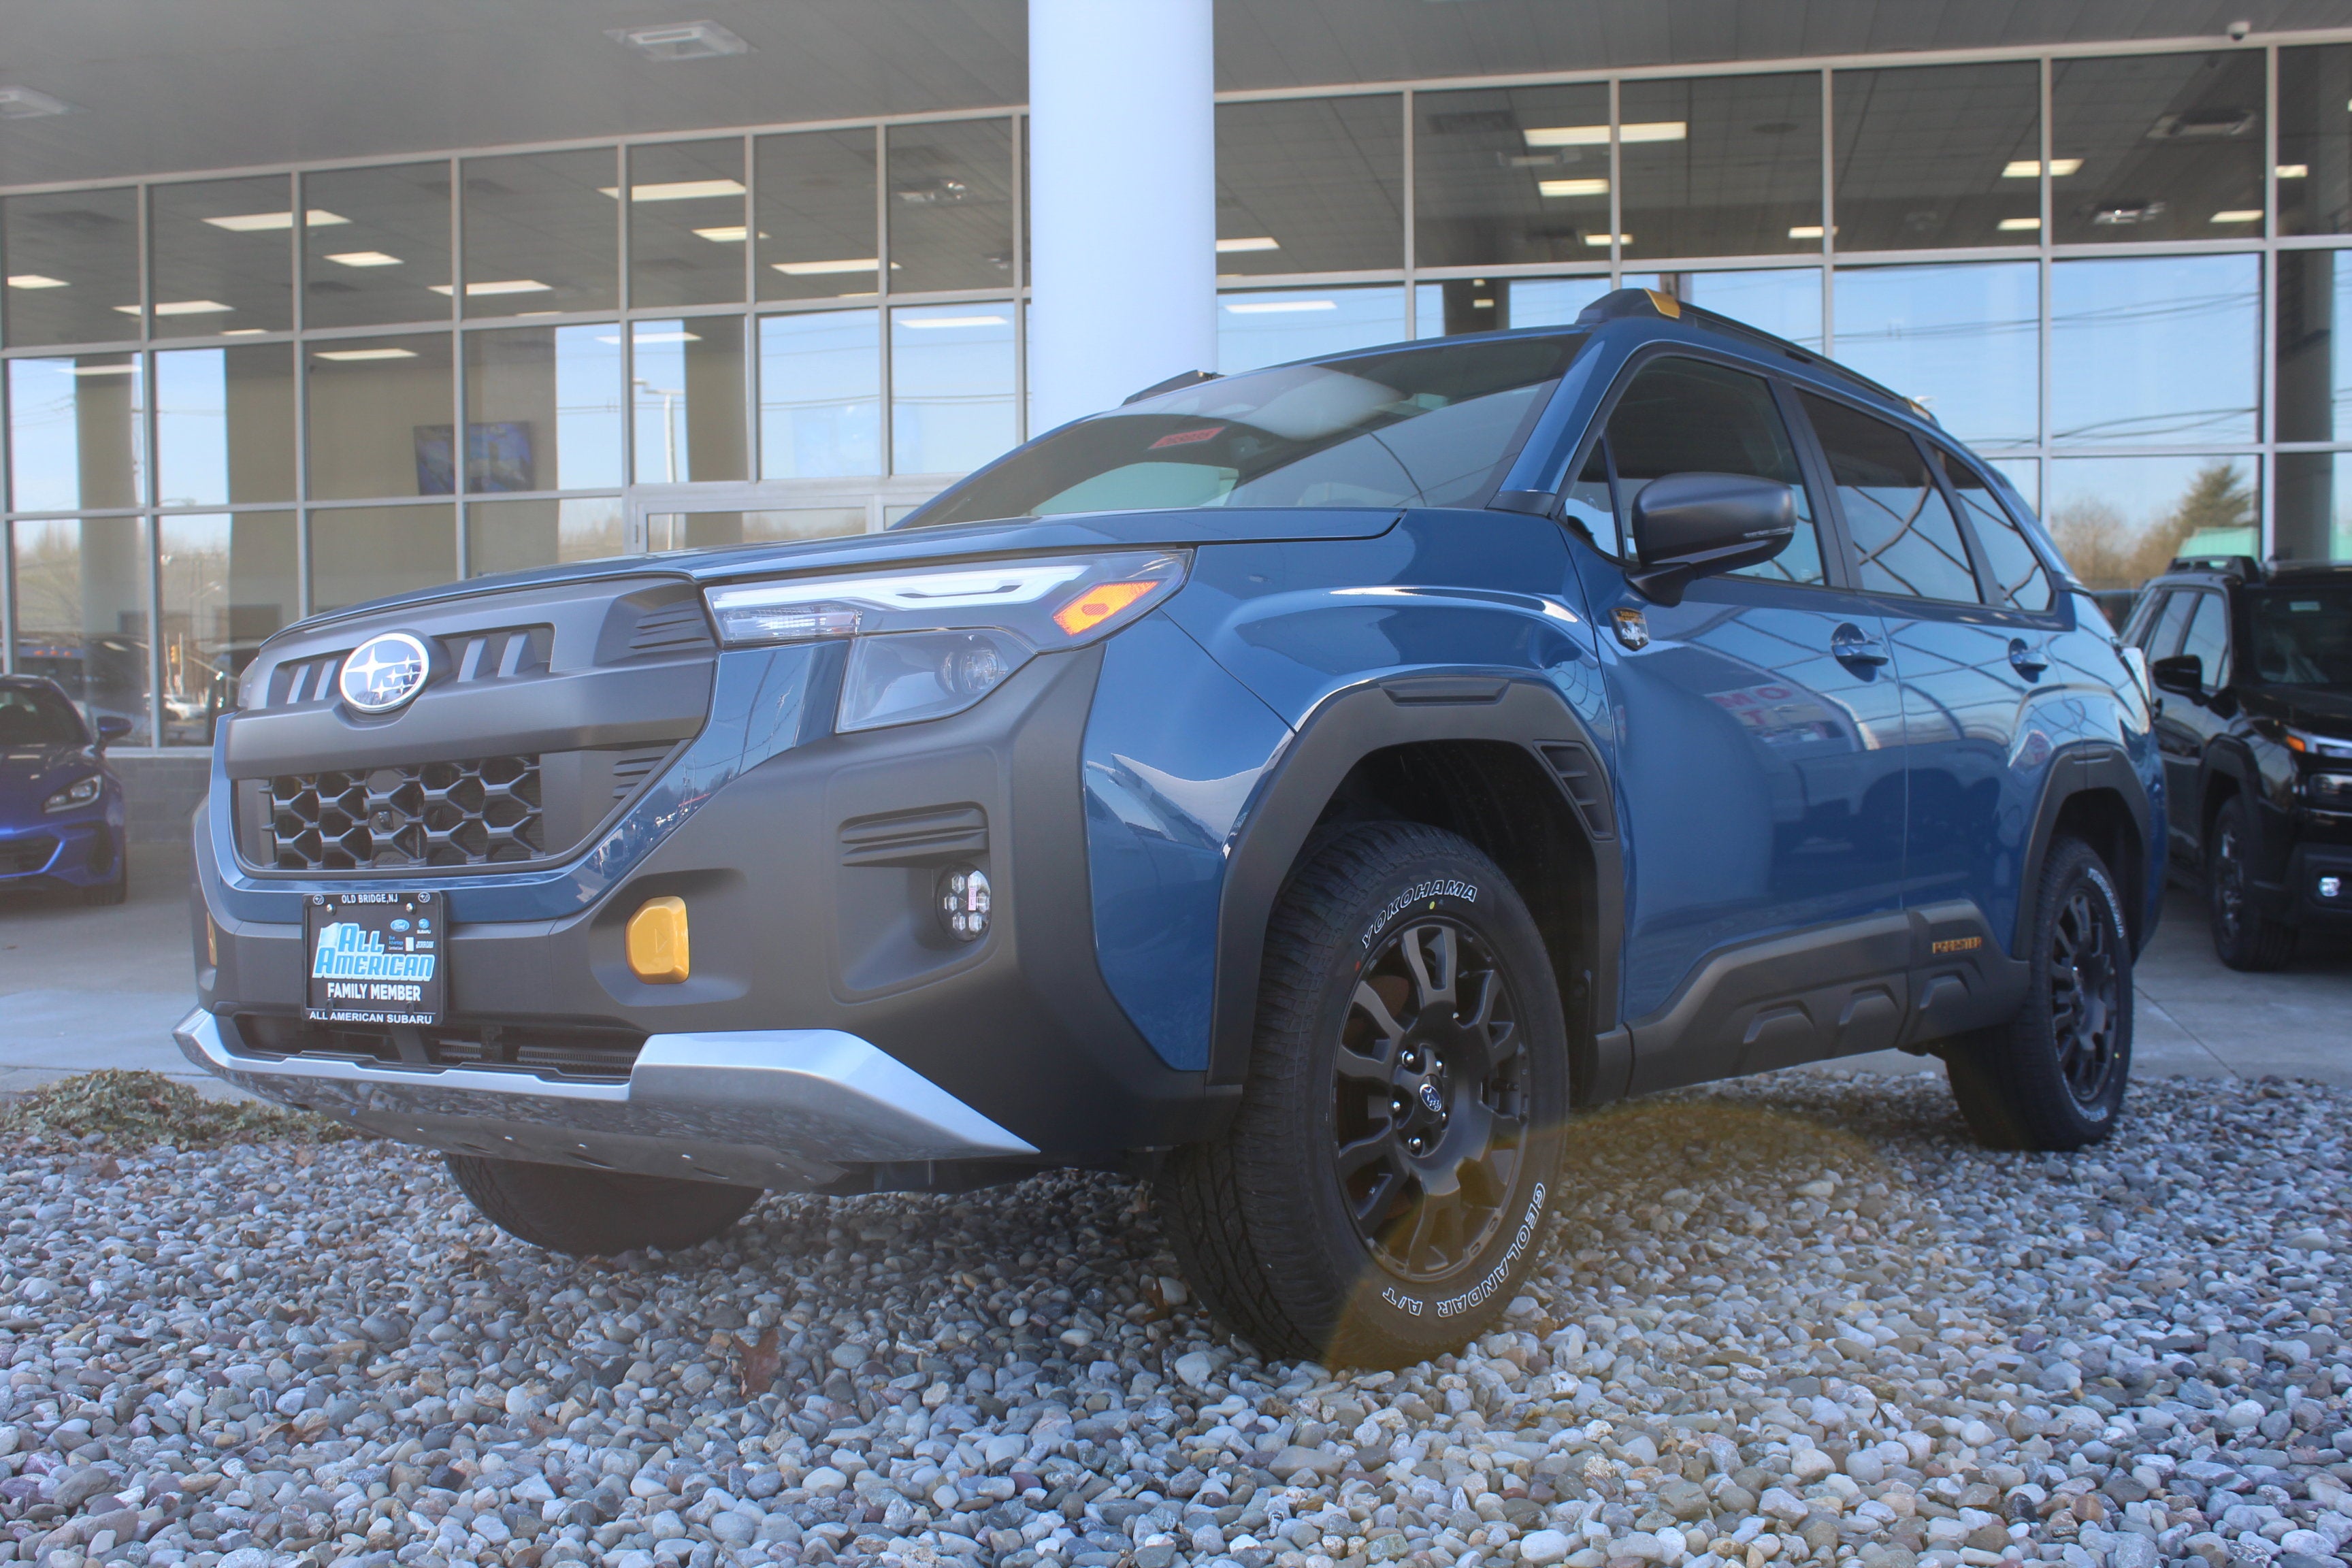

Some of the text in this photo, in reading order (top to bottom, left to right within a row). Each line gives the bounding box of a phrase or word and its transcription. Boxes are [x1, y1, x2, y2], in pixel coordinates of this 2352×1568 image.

[342, 894, 356, 904] OLD
[1362, 880, 1477, 949] YOKOHAMA
[312, 947, 435, 981] AMERICAN
[327, 982, 421, 1001] FAMILY MEMBER
[310, 1011, 432, 1024] ALL AMERICAN SUBARU
[1382, 1183, 1546, 1318] GEOLANDAR A/T
